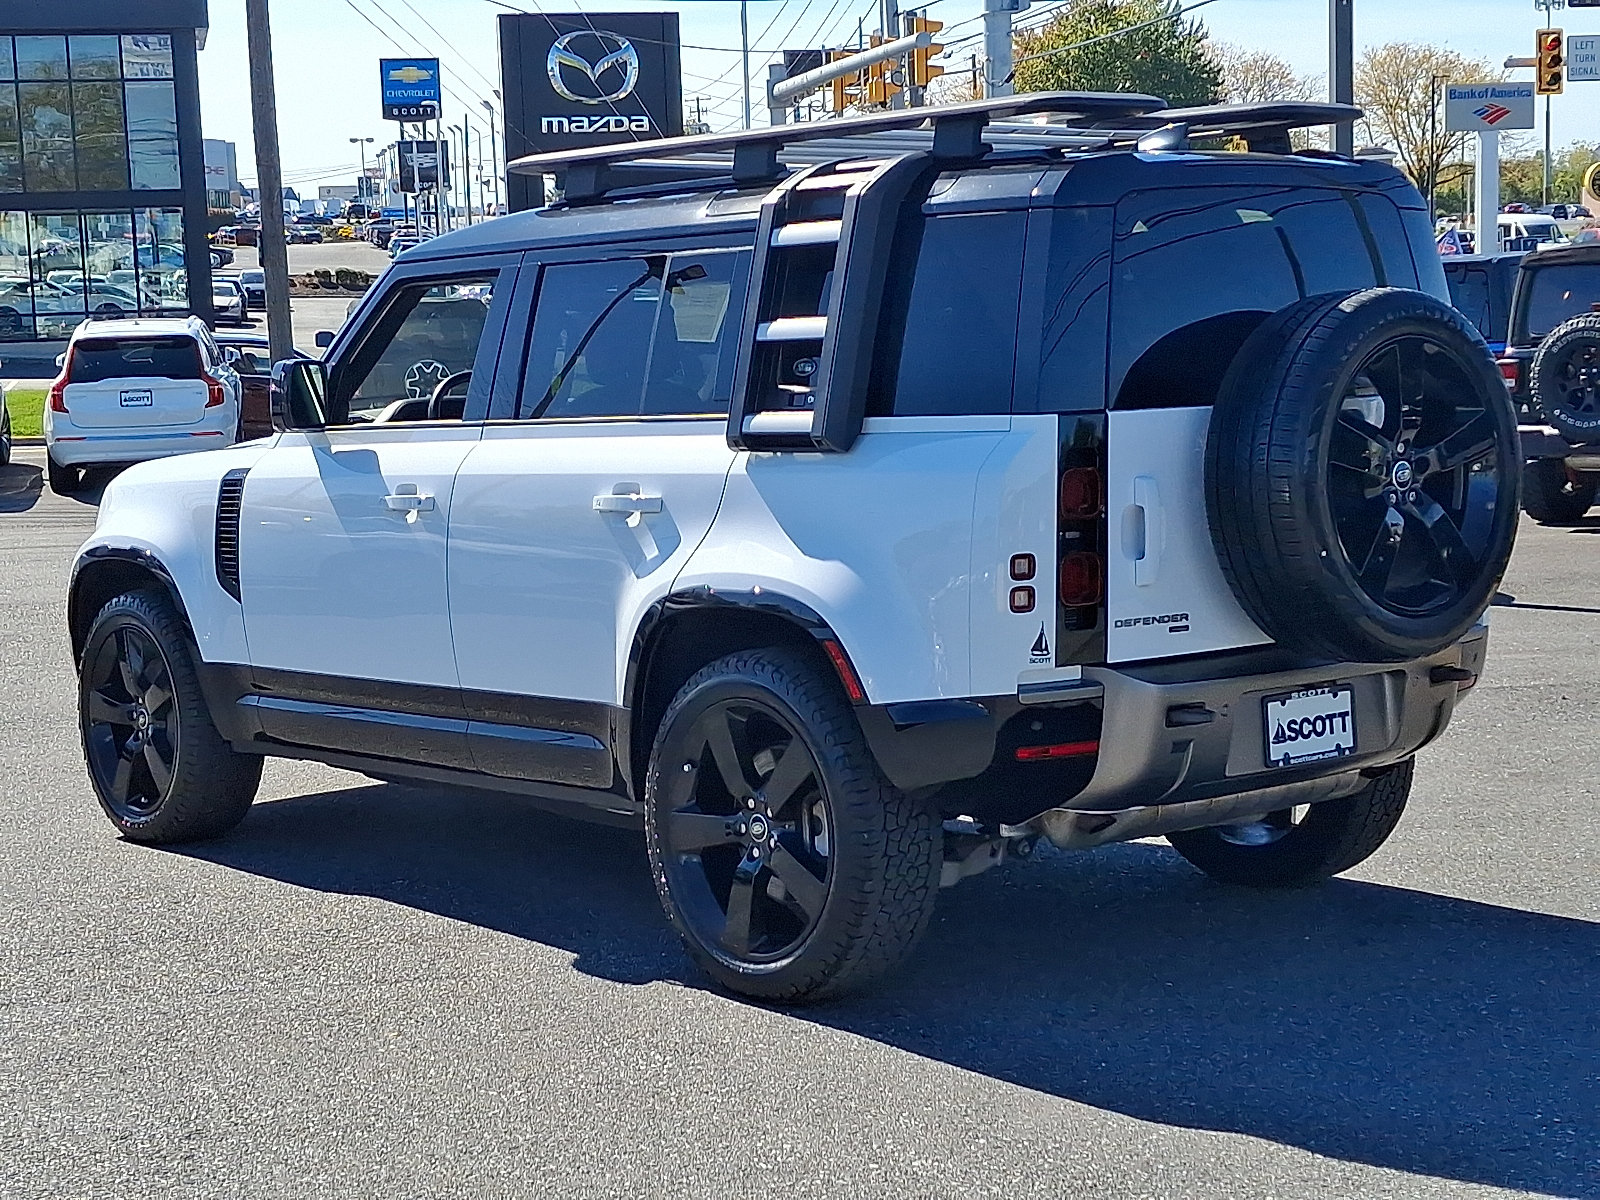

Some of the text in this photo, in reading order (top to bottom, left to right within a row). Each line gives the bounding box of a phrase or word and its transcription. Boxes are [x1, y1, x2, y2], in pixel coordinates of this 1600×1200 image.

[1575, 41, 1595, 50] LEFT
[1575, 54, 1596, 63] TURN
[1570, 66, 1599, 76] SIGNAL
[386, 89, 435, 98] CHEVROLET
[1449, 87, 1532, 100] Bank of America
[392, 107, 432, 116] SCOTT
[1114, 613, 1189, 629] DEFENDER
[1291, 687, 1330, 699] SCOTT
[1286, 710, 1350, 742] SCOTT
